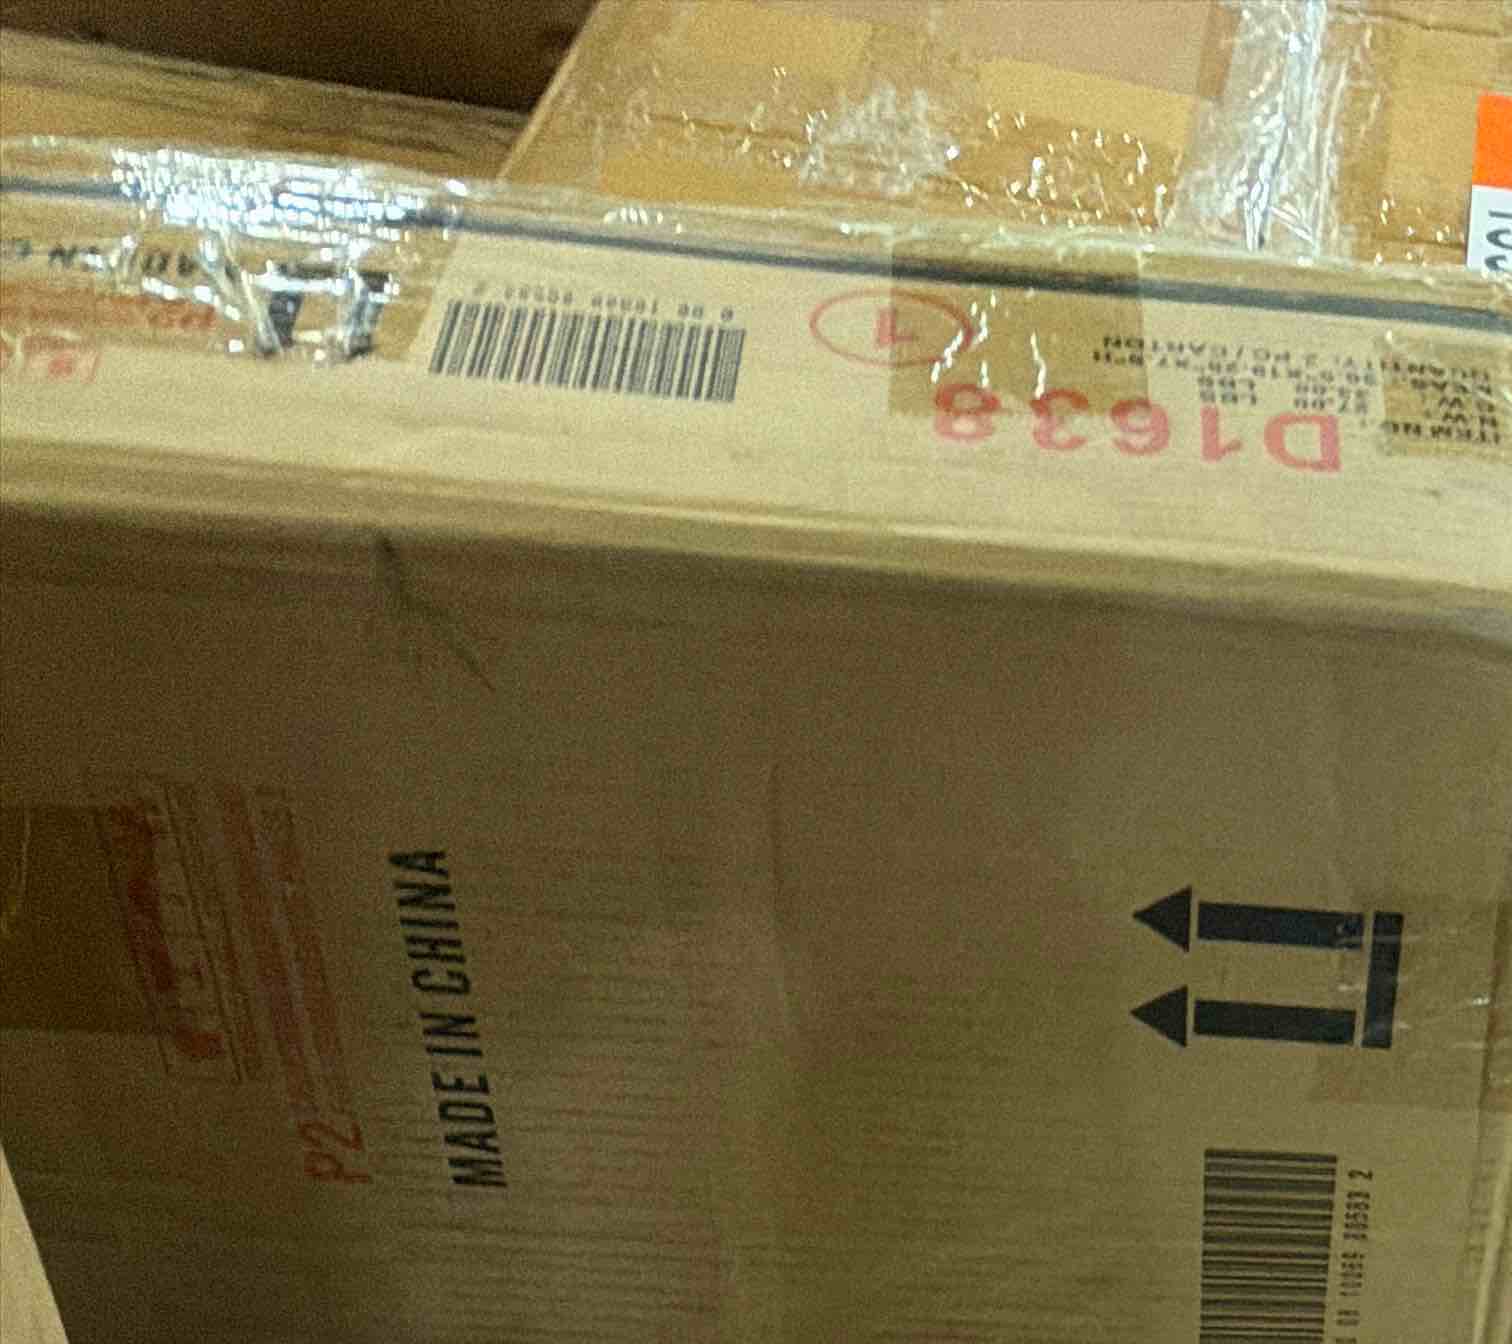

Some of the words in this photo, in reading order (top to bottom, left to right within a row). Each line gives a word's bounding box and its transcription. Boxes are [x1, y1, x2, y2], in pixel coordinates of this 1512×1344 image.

[933, 383, 1341, 472] D1638
[388, 849, 471, 995] CHINA
[418, 1011, 483, 1057] IN
[431, 1071, 507, 1188] MADE
[1347, 1168, 1374, 1182] 2
